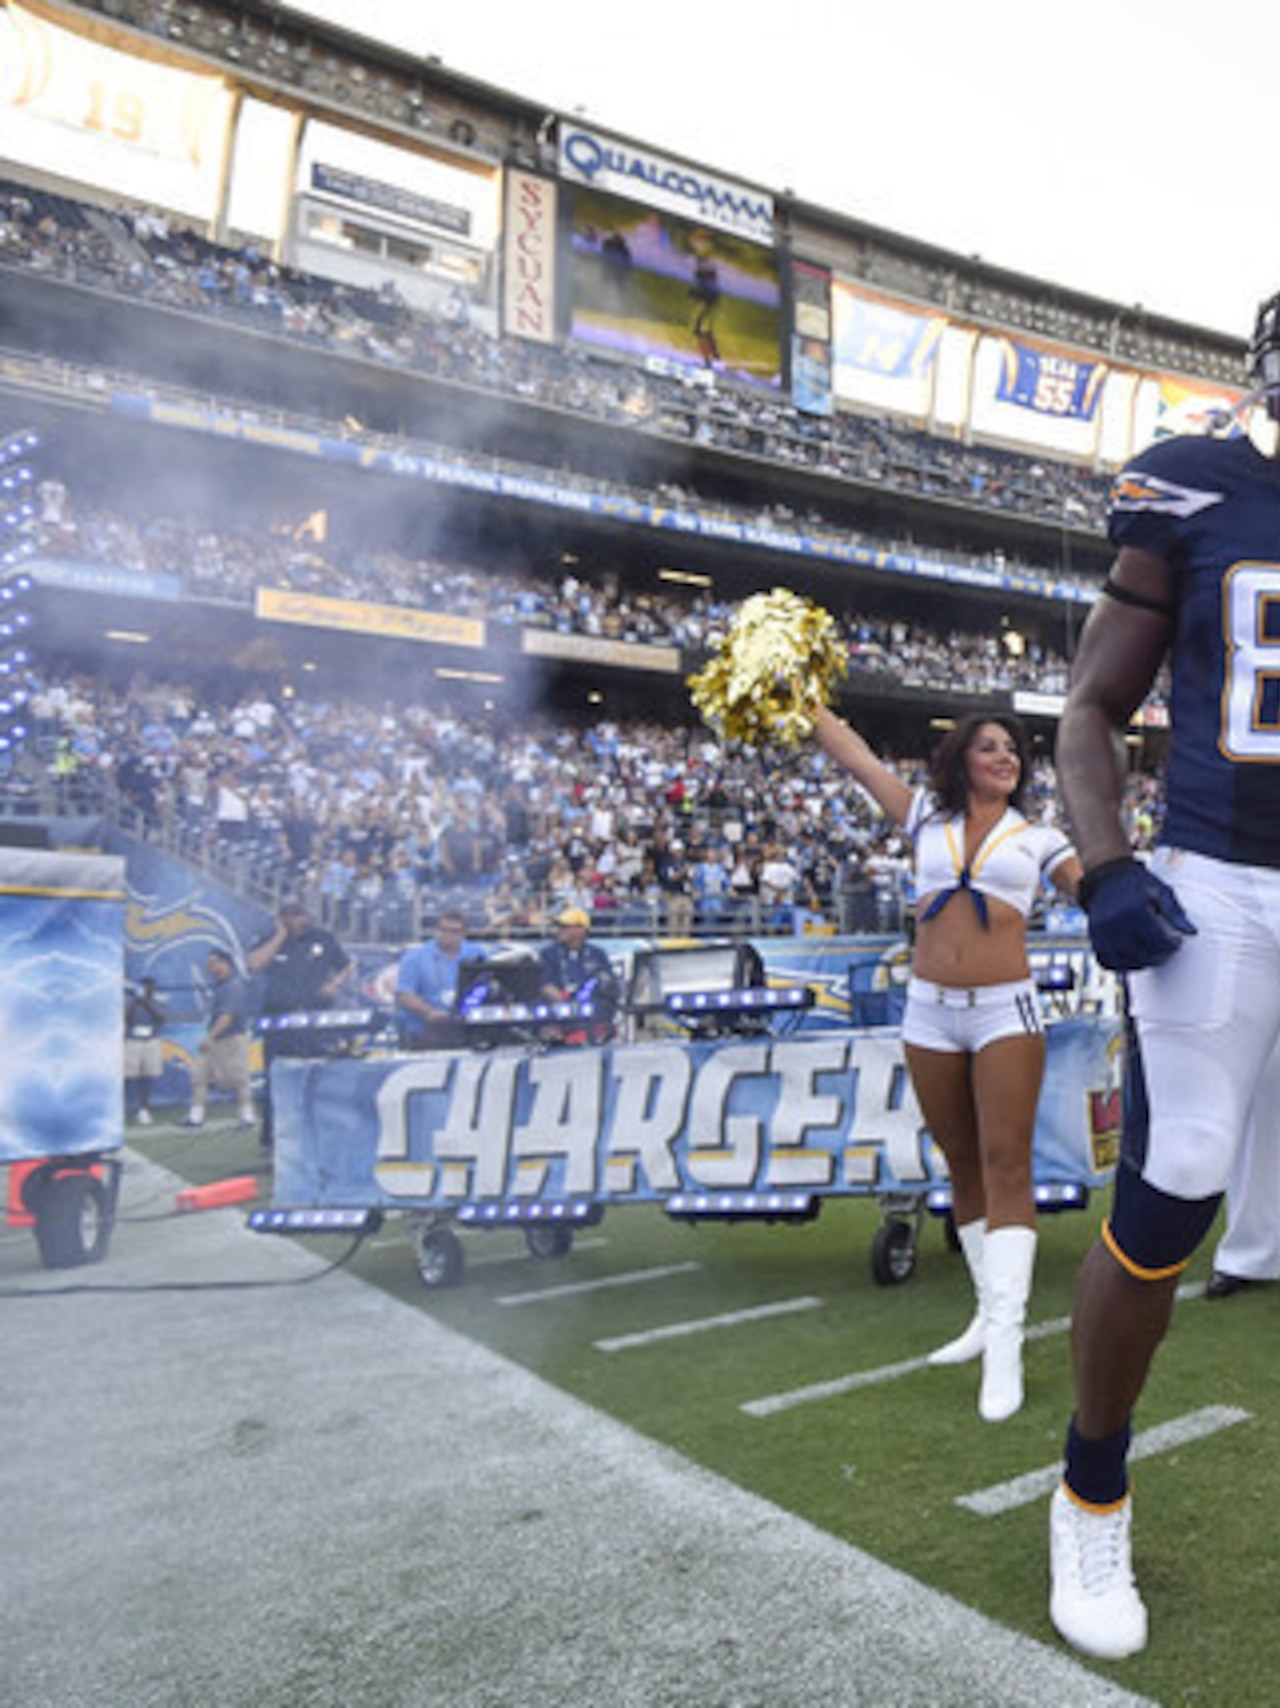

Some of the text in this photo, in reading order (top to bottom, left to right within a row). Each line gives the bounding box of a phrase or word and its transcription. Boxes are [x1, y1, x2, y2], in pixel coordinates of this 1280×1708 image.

[564, 132, 773, 226] QUALCOMM
[517, 180, 543, 334] SYCUAN
[1033, 376, 1077, 416] 55
[373, 1035, 951, 1197] CHARGER
